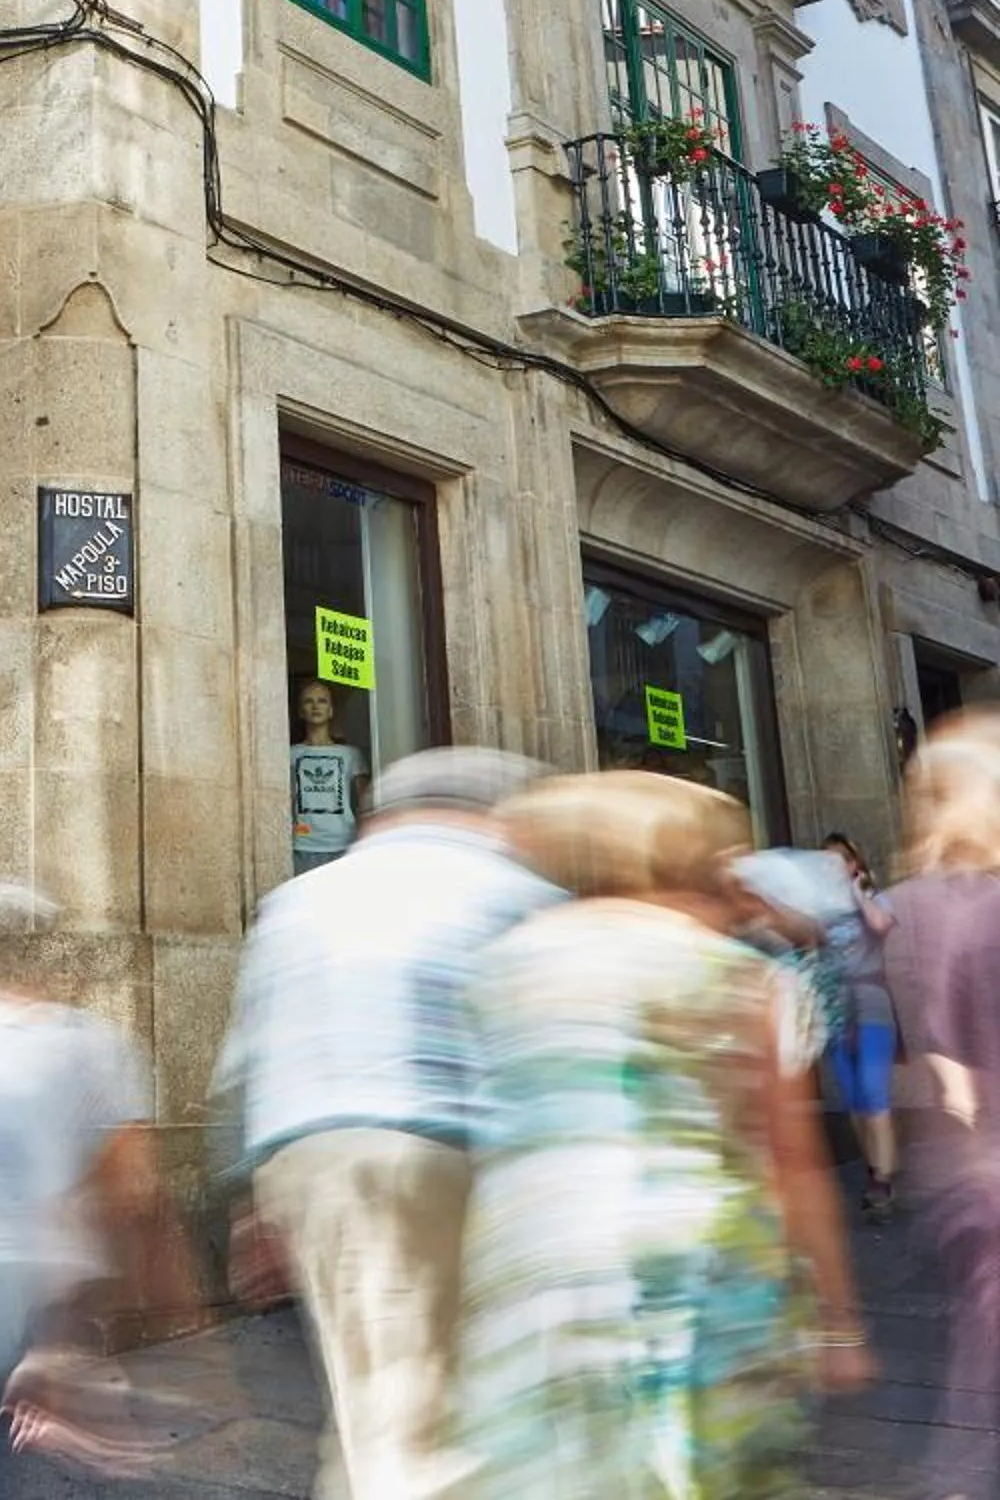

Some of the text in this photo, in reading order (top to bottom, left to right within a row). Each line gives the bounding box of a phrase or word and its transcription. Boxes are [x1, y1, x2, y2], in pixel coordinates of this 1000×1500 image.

[55, 493, 128, 519] HOSTAL
[55, 520, 124, 591] MAPOULA
[86, 573, 127, 593] PISO
[321, 615, 367, 642] Rebaixas
[325, 637, 365, 662] Rebajas
[331, 659, 360, 681] Sales
